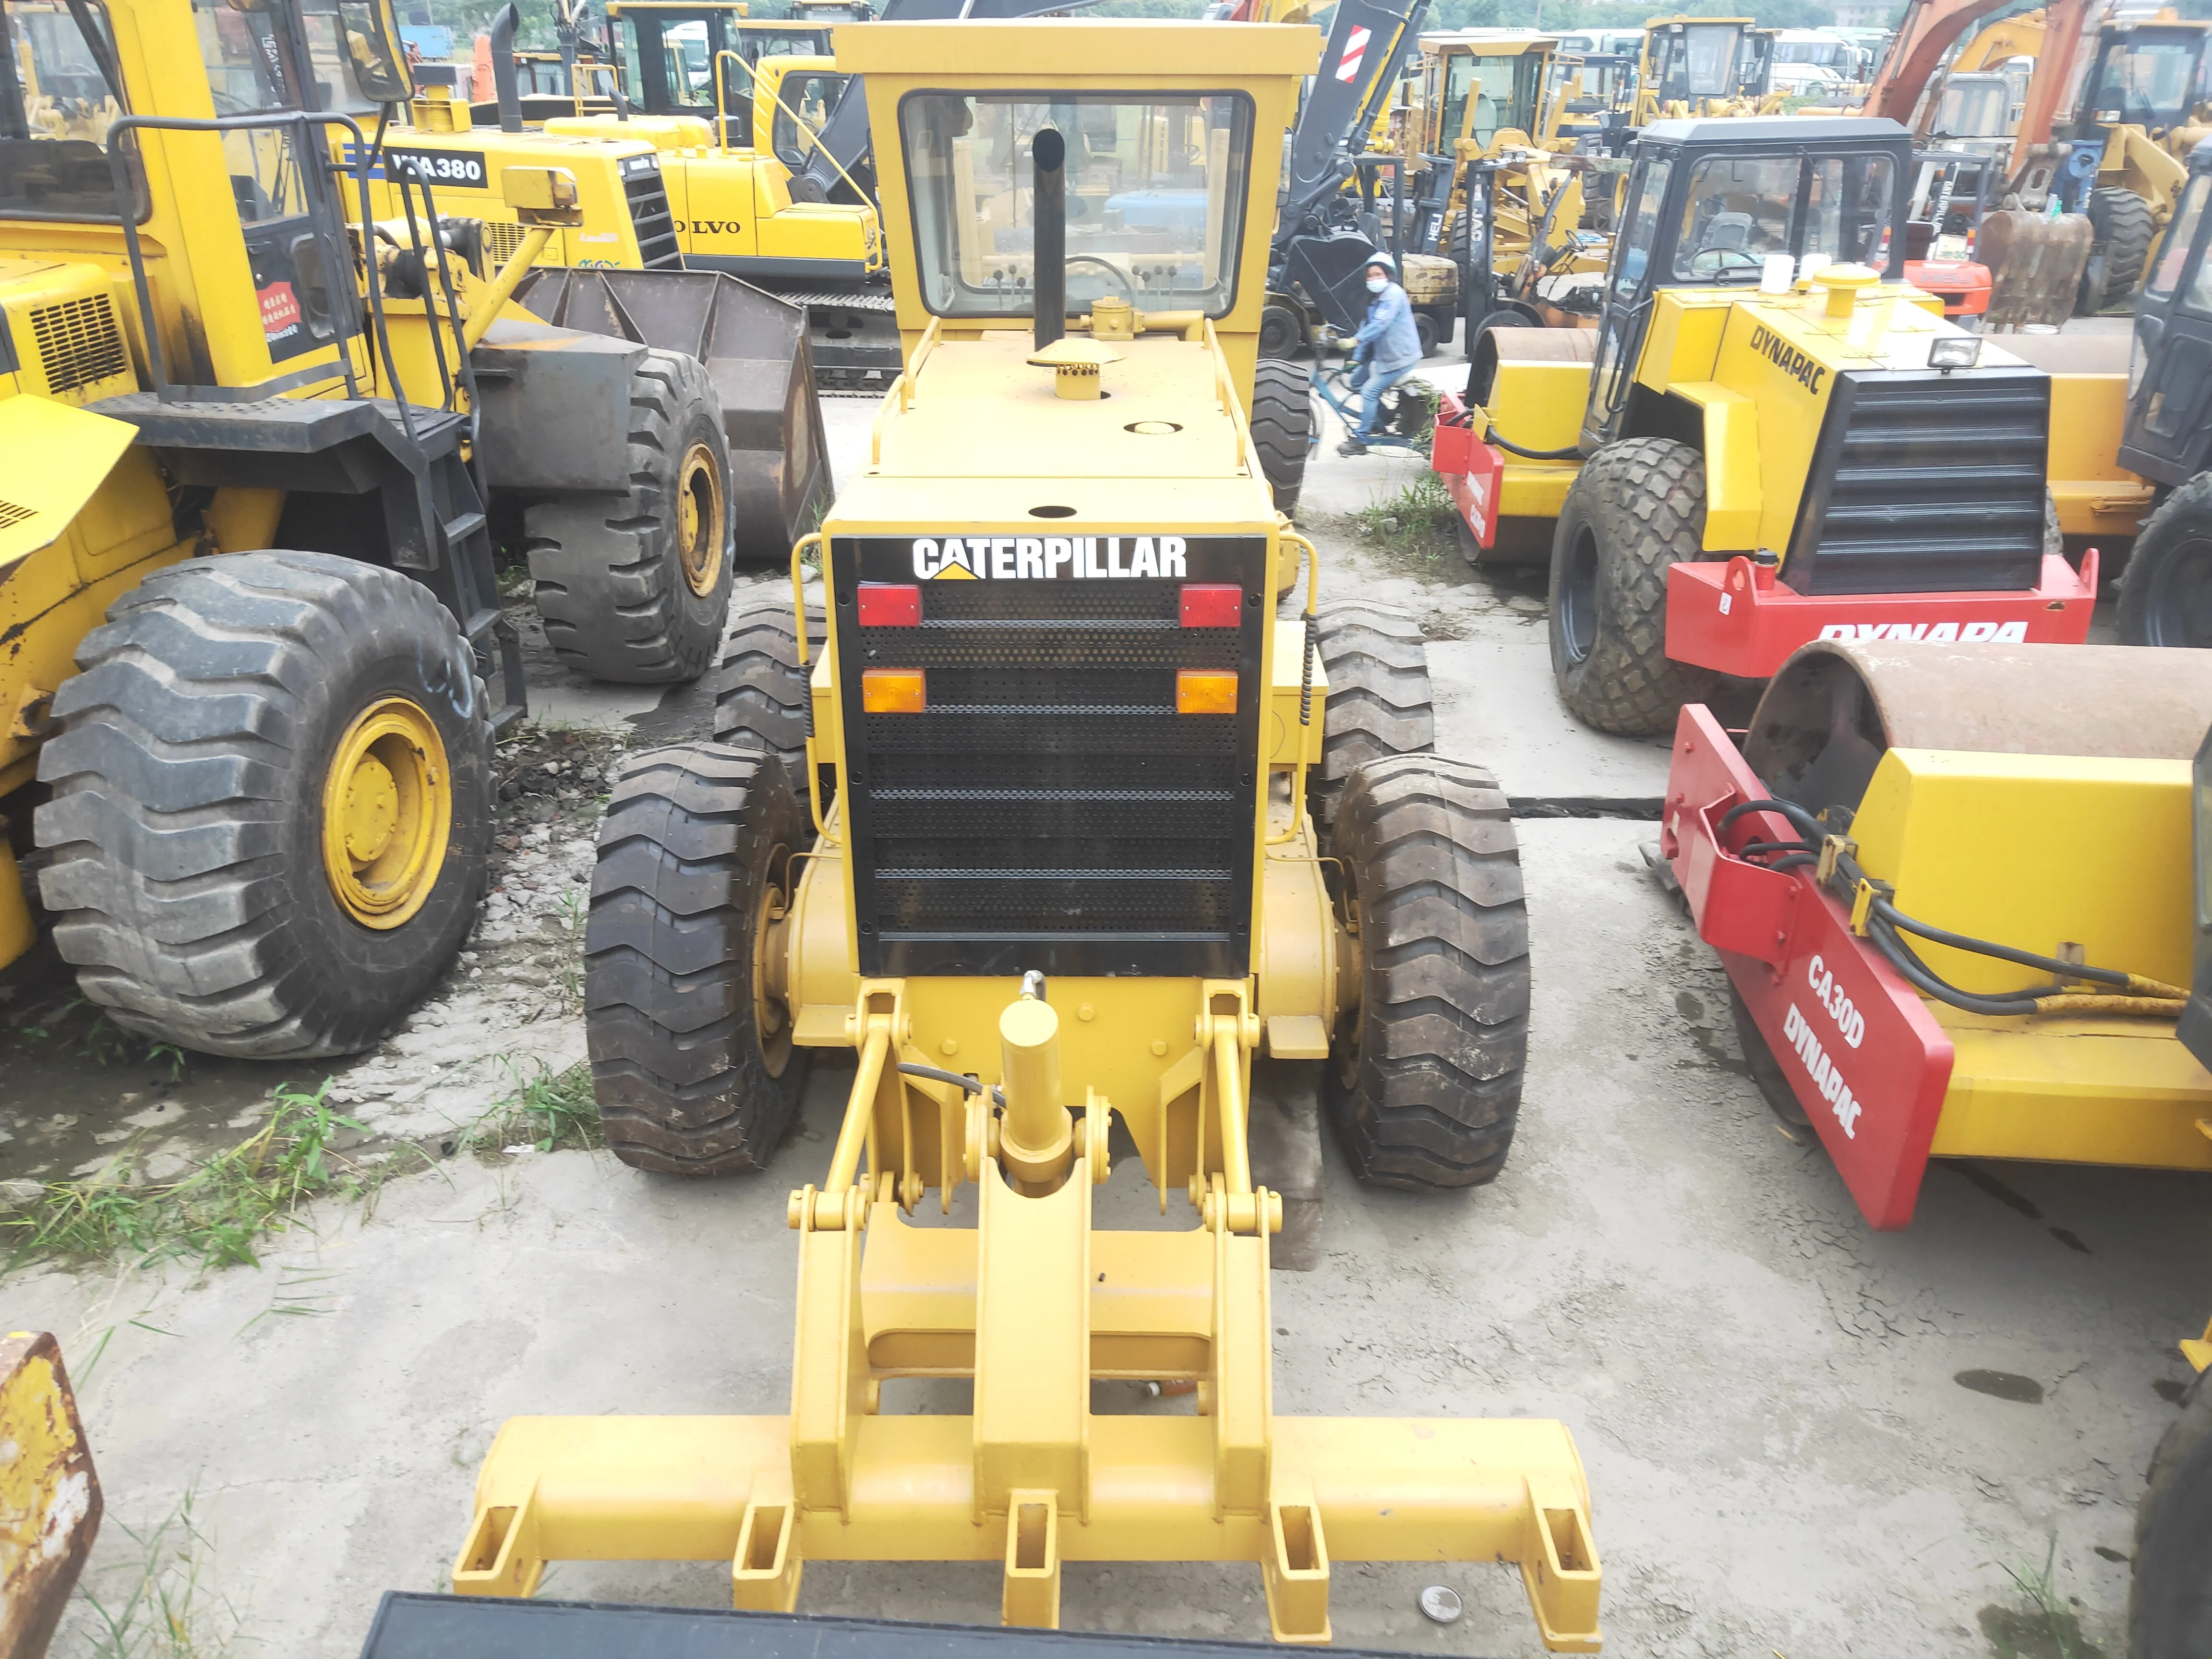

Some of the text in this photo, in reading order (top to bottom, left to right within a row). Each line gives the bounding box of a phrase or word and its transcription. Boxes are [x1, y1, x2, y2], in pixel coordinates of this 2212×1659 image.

[392, 154, 481, 180] WA380
[674, 220, 740, 234] OLVO
[1428, 214, 1443, 241] HELI
[1921, 273, 1972, 284] HELI
[1750, 325, 1826, 395] DYNAPAC
[913, 536, 1187, 580] CATERPILLAR
[1808, 955, 1865, 1048] CA30D
[1783, 1002, 1862, 1140] DYNAPAC
